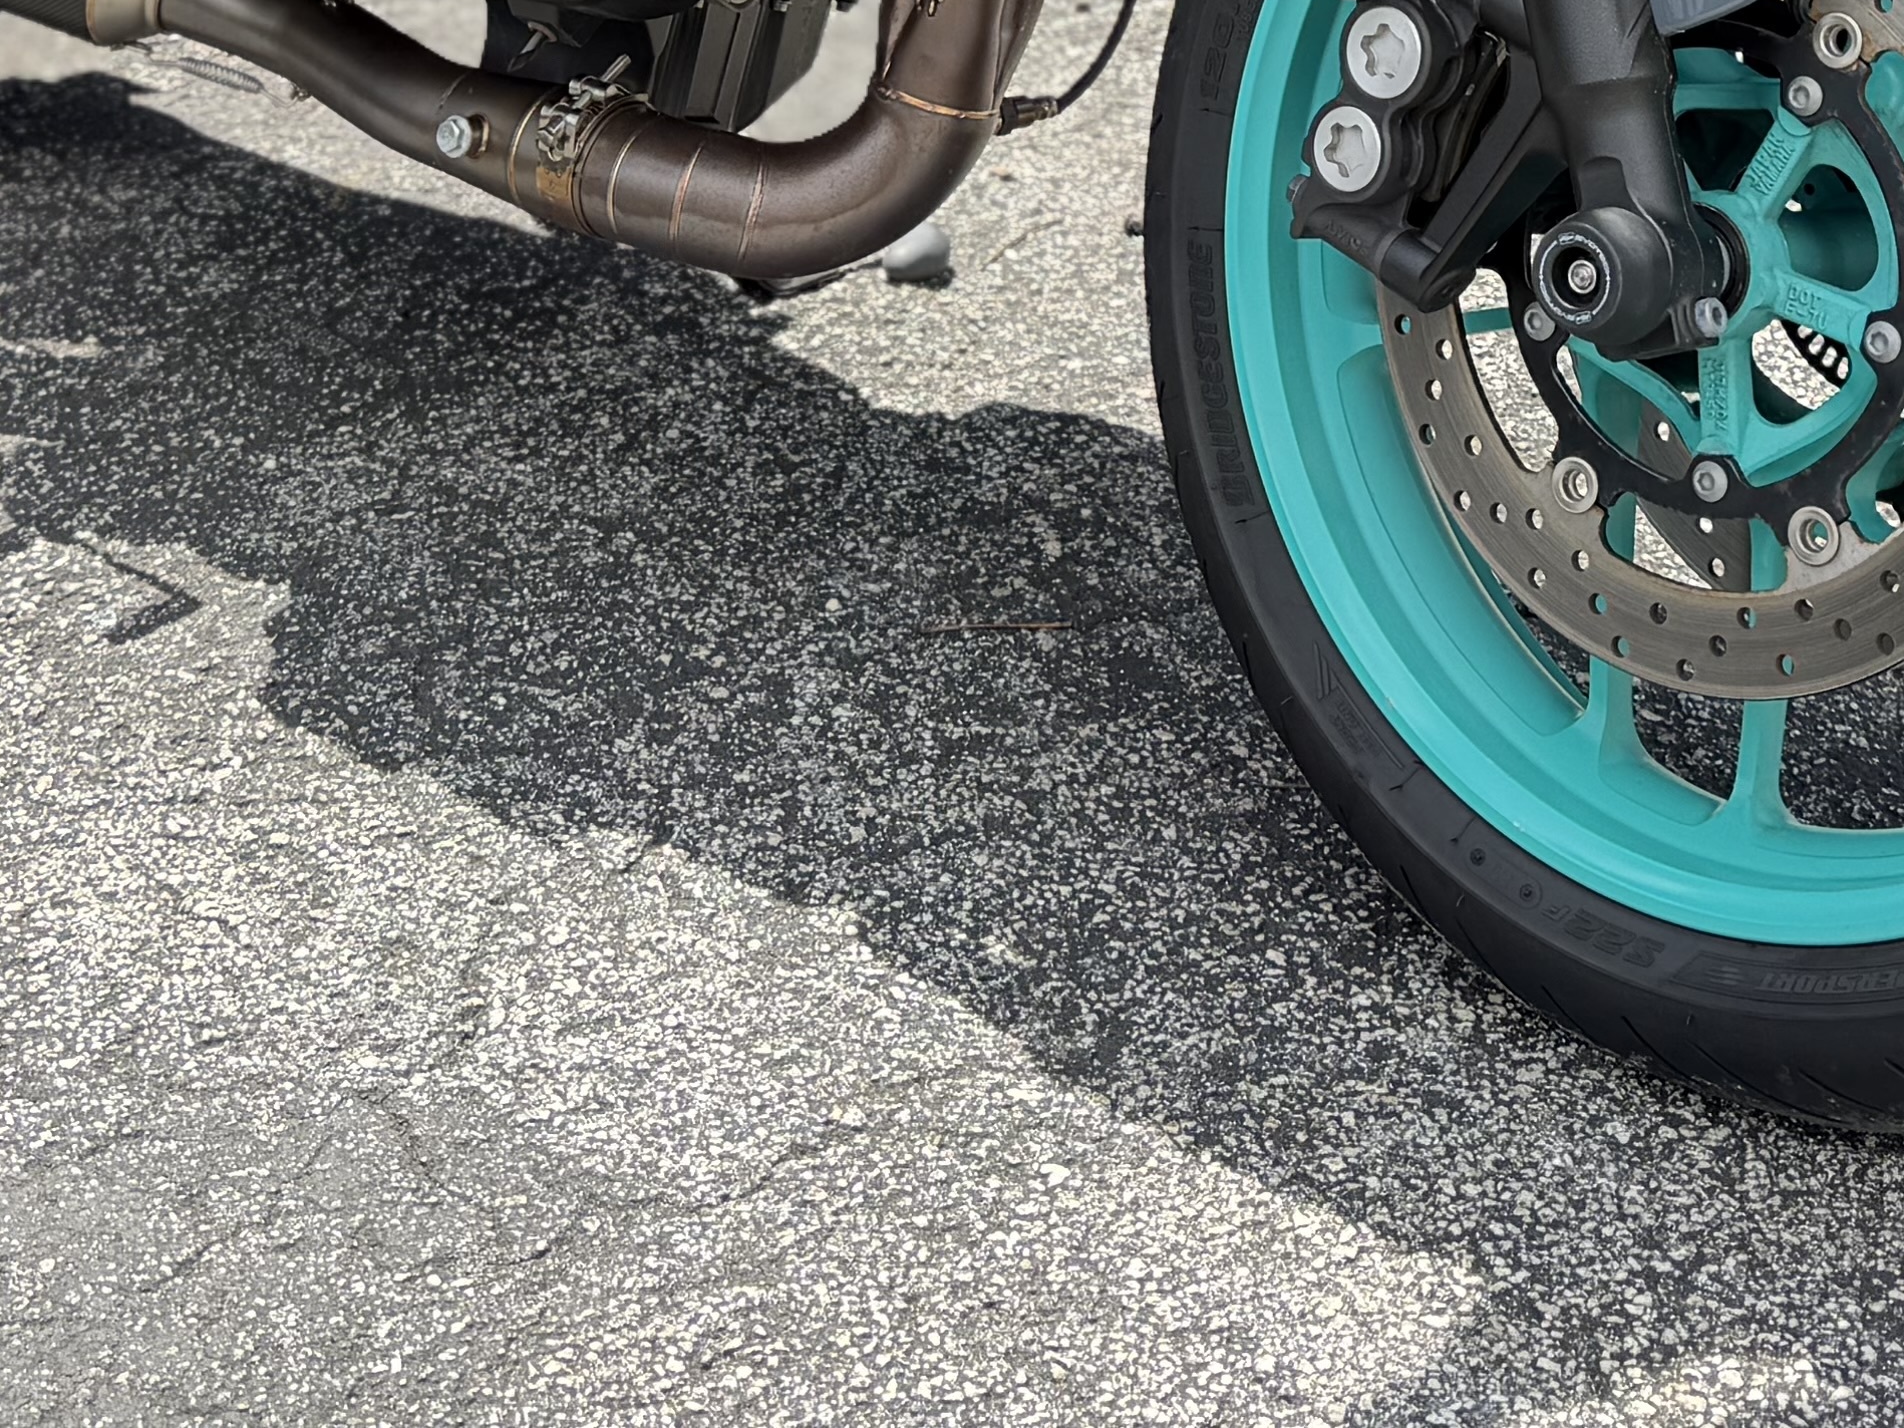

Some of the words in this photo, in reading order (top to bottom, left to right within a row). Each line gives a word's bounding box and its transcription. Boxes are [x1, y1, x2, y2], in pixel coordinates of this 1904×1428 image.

[1788, 282, 1821, 309] DOT
[1204, 239, 1255, 508] BRIDGESTONE
[1561, 906, 1666, 970] S22
